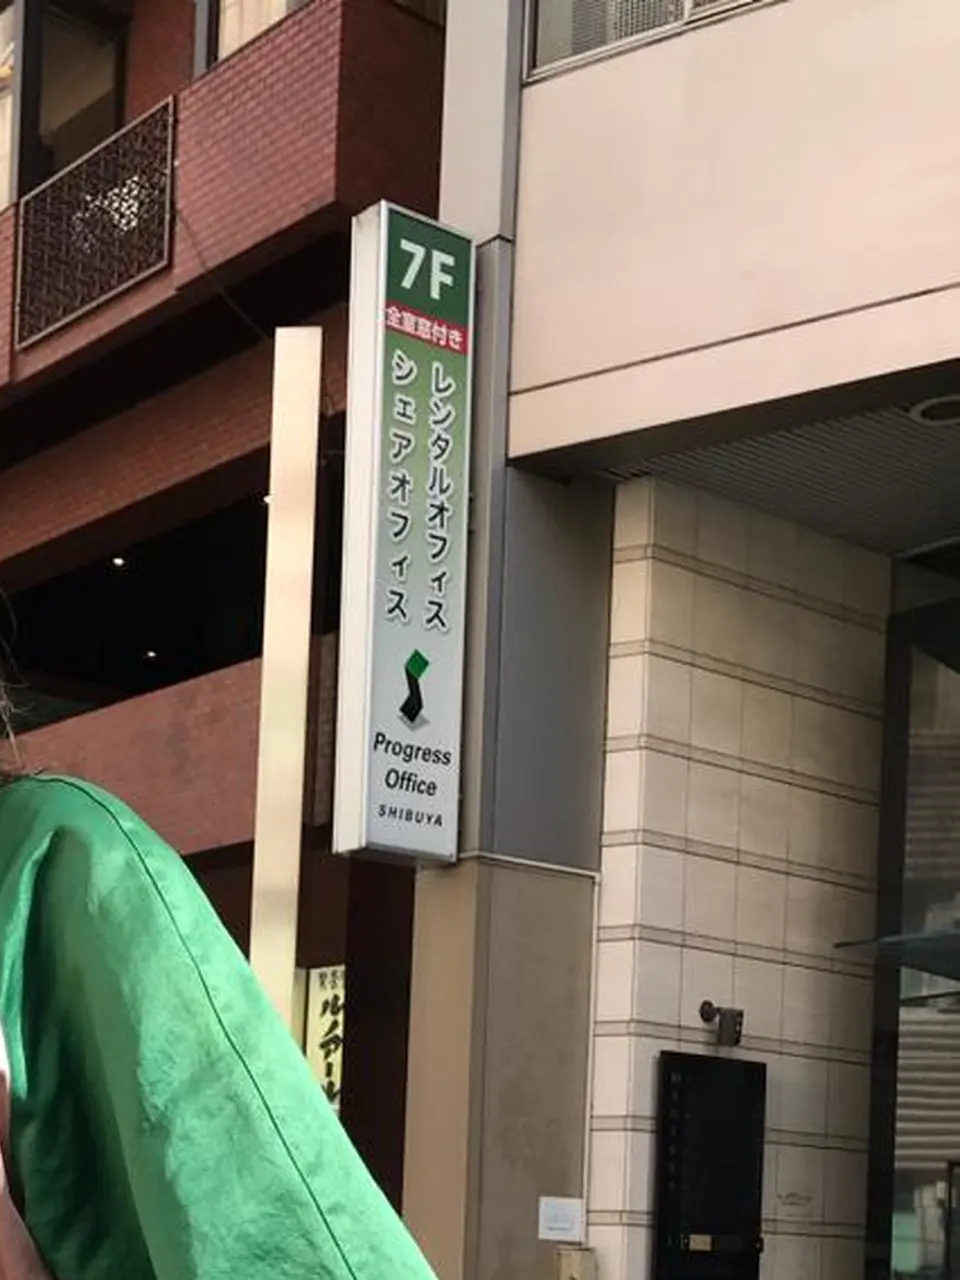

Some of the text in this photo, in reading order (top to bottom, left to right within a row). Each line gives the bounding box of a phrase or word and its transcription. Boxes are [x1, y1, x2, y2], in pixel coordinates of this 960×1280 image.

[400, 238, 456, 300] 7F
[387, 351, 416, 620] シェアオフィス
[425, 363, 453, 629] レンタルオフィス
[373, 731, 452, 766] Progress
[384, 767, 437, 796] Office
[378, 804, 443, 828] SHIBUYA
